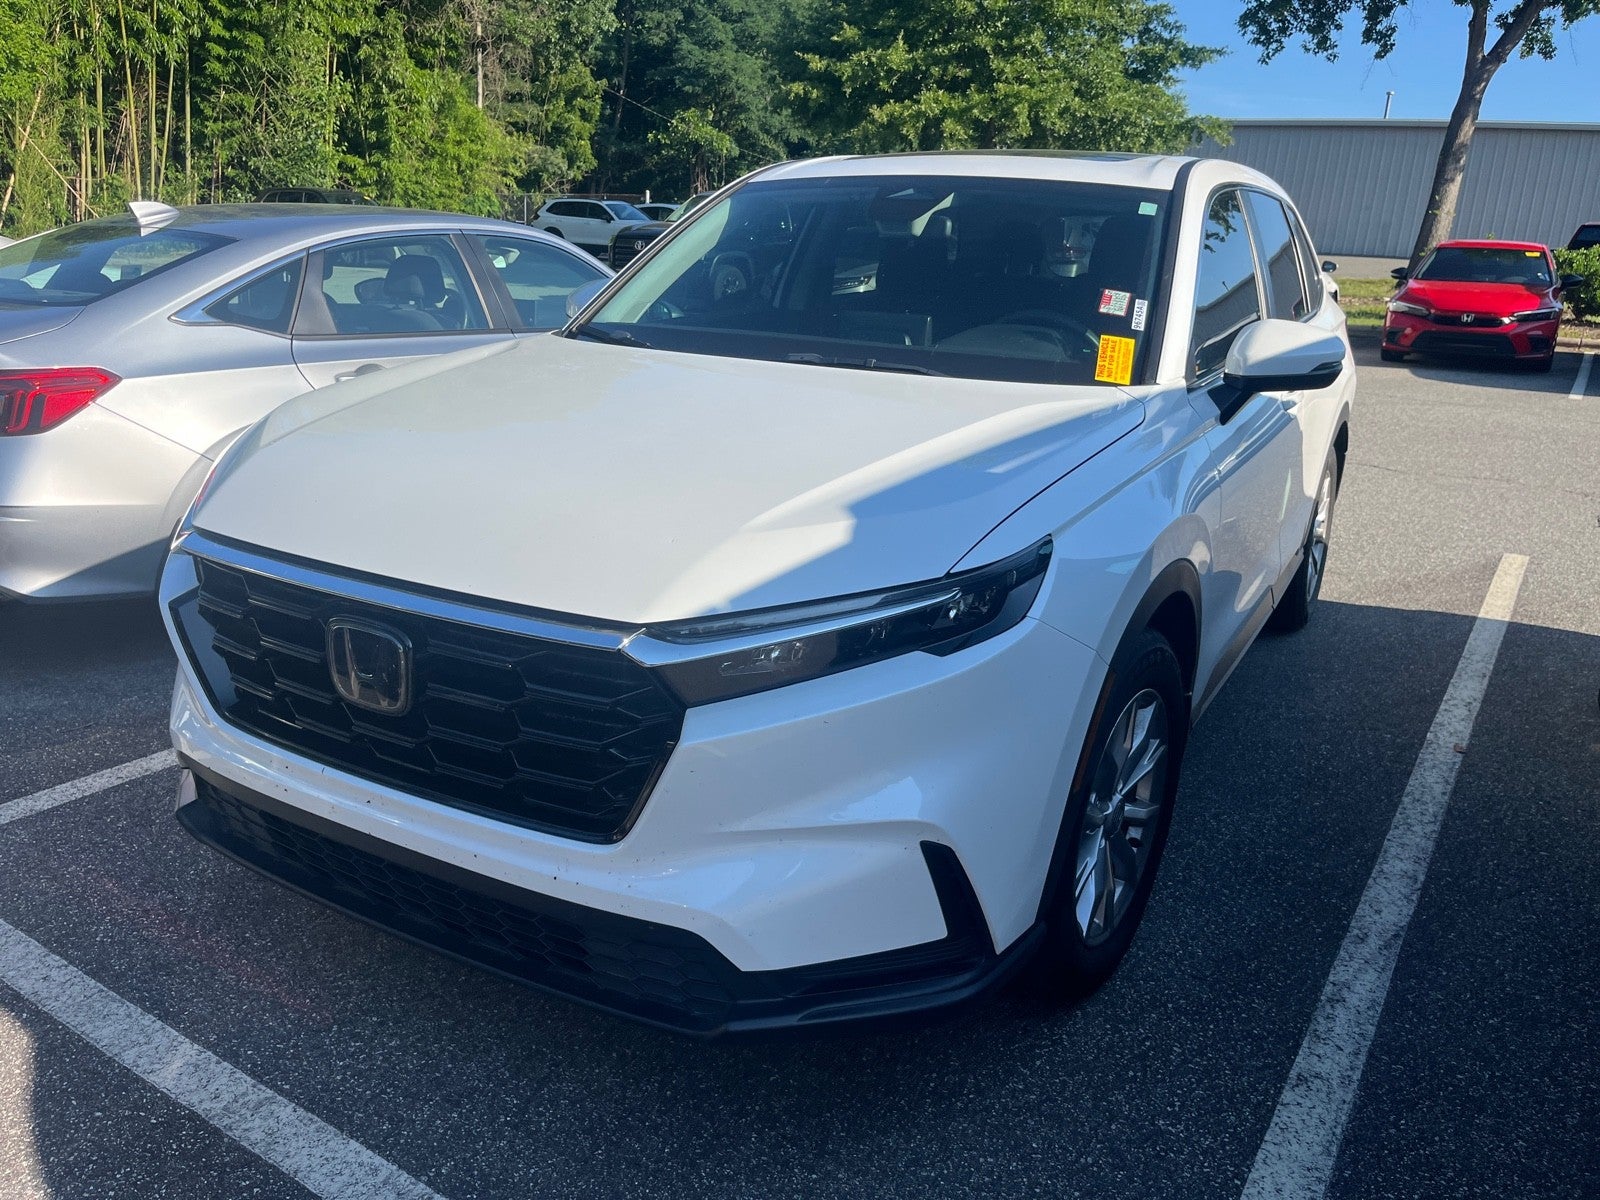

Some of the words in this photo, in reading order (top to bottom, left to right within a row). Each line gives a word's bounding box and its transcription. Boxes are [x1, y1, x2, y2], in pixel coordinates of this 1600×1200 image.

[1099, 337, 1110, 362] VEHICLE
[1097, 363, 1106, 378] THIS
[1106, 367, 1114, 378] NOT
